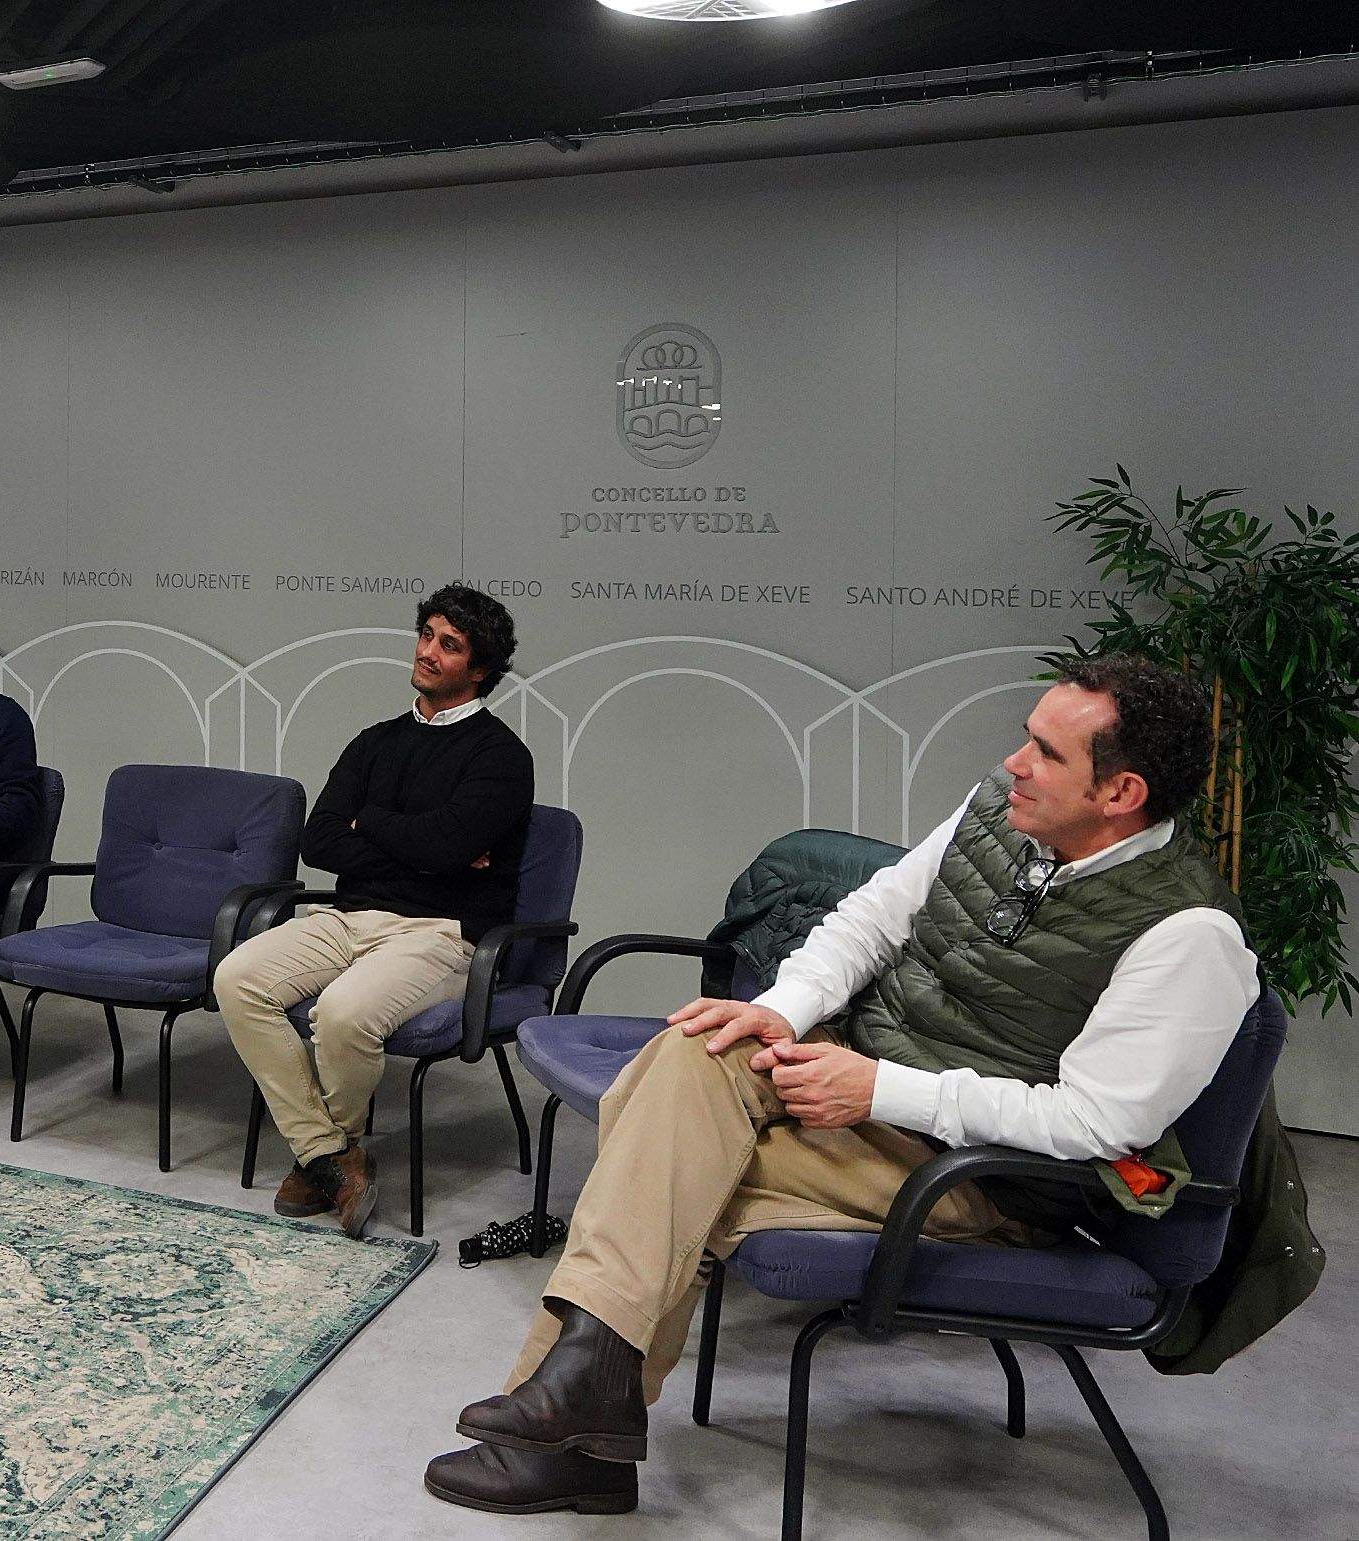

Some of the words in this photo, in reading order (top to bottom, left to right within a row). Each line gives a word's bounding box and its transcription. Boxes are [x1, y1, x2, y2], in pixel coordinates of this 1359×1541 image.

[591, 487, 707, 503] CONCELLO
[714, 487, 746, 503] DE
[559, 511, 781, 539] PONTEVEDRA
[62, 567, 133, 587] MARCÓN
[155, 572, 251, 590] MOURENTE
[275, 575, 335, 593] PONTE
[341, 576, 425, 594] SAMPAIO
[570, 581, 638, 600] SANTA
[643, 578, 714, 602] MARÍA
[720, 584, 749, 603] DE
[756, 585, 811, 604] XEVE
[845, 586, 927, 606] SANTO
[933, 584, 1020, 608] ANDRÉ
[1030, 588, 1062, 608] DE
